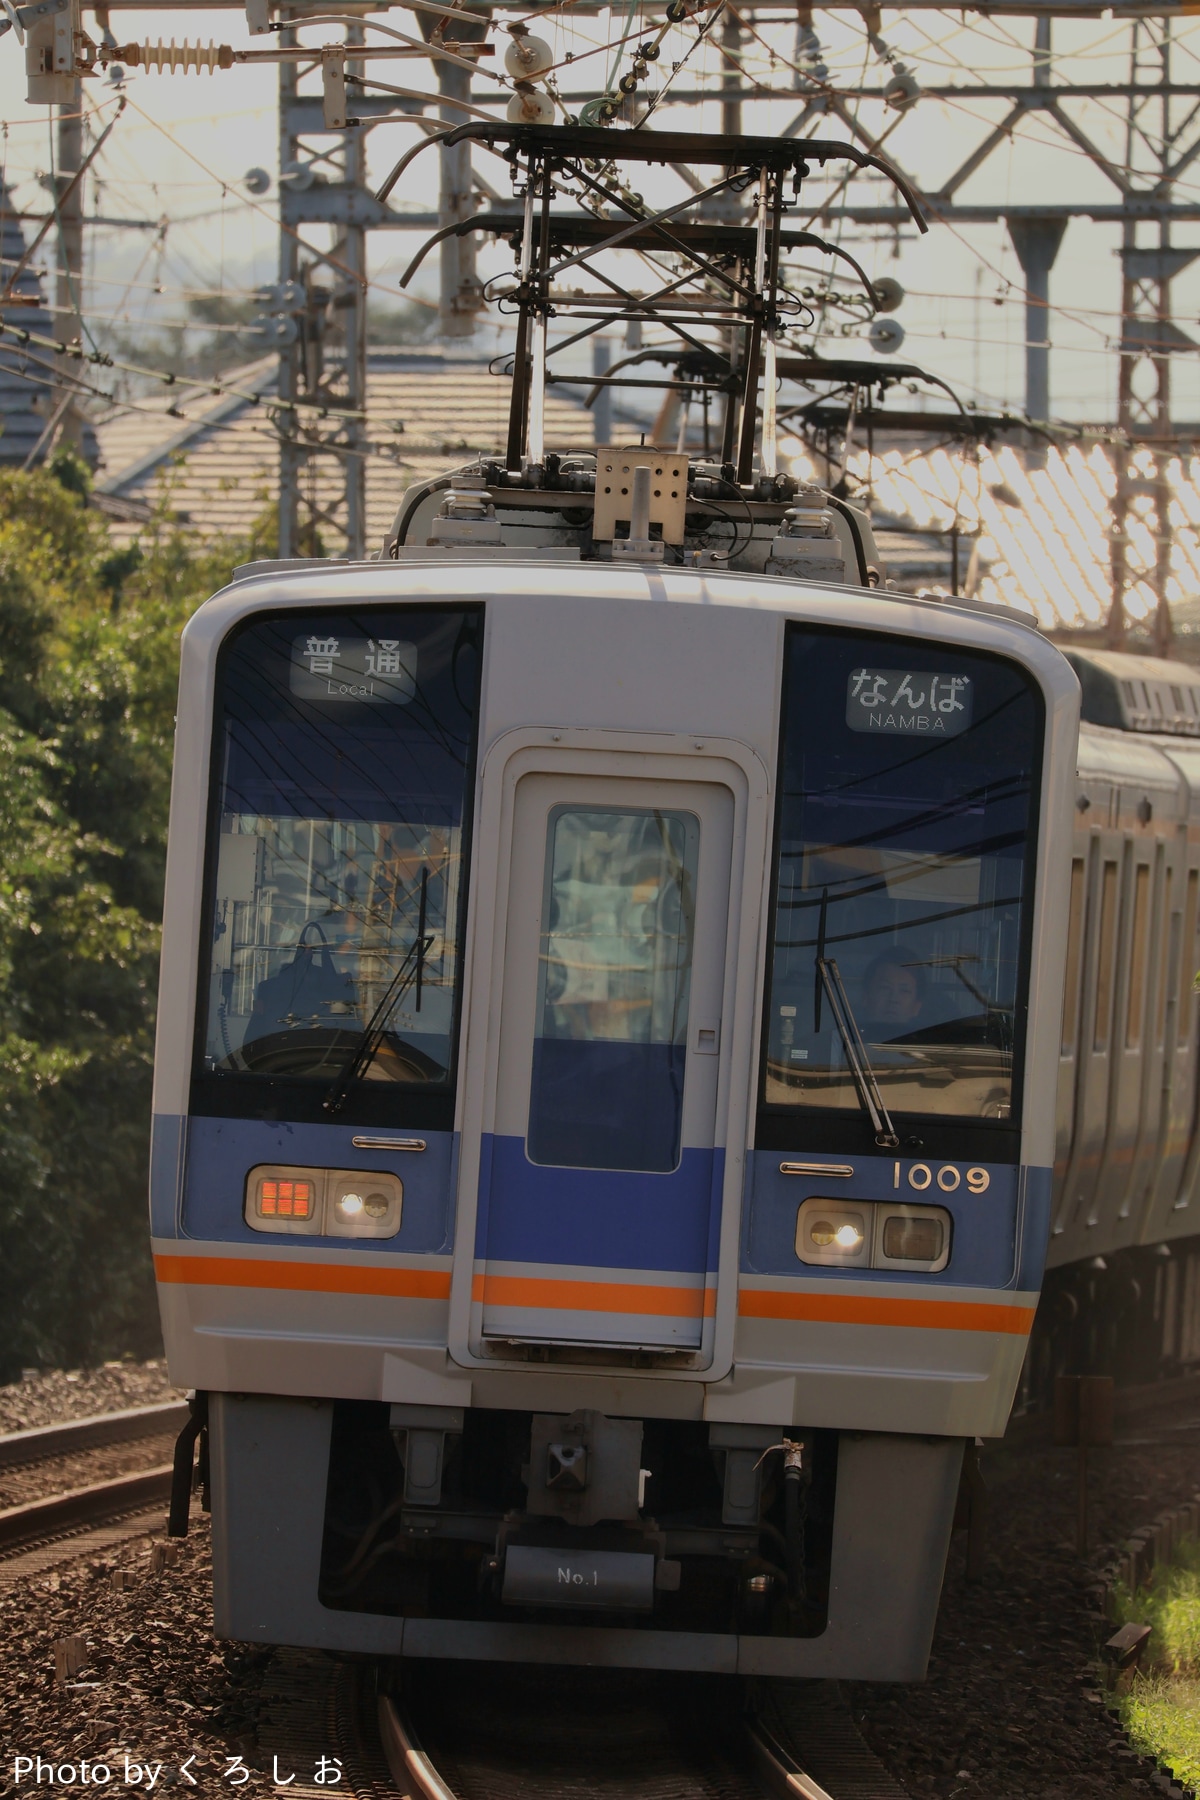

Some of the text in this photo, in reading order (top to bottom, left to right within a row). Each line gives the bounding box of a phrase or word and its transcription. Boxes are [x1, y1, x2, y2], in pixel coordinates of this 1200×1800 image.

[303, 636, 402, 678] 普通
[327, 680, 374, 696] Local
[851, 668, 970, 713] なんば
[869, 712, 946, 732] NAMBA
[893, 1161, 990, 1194] 1009
[558, 1567, 598, 1586] No.1
